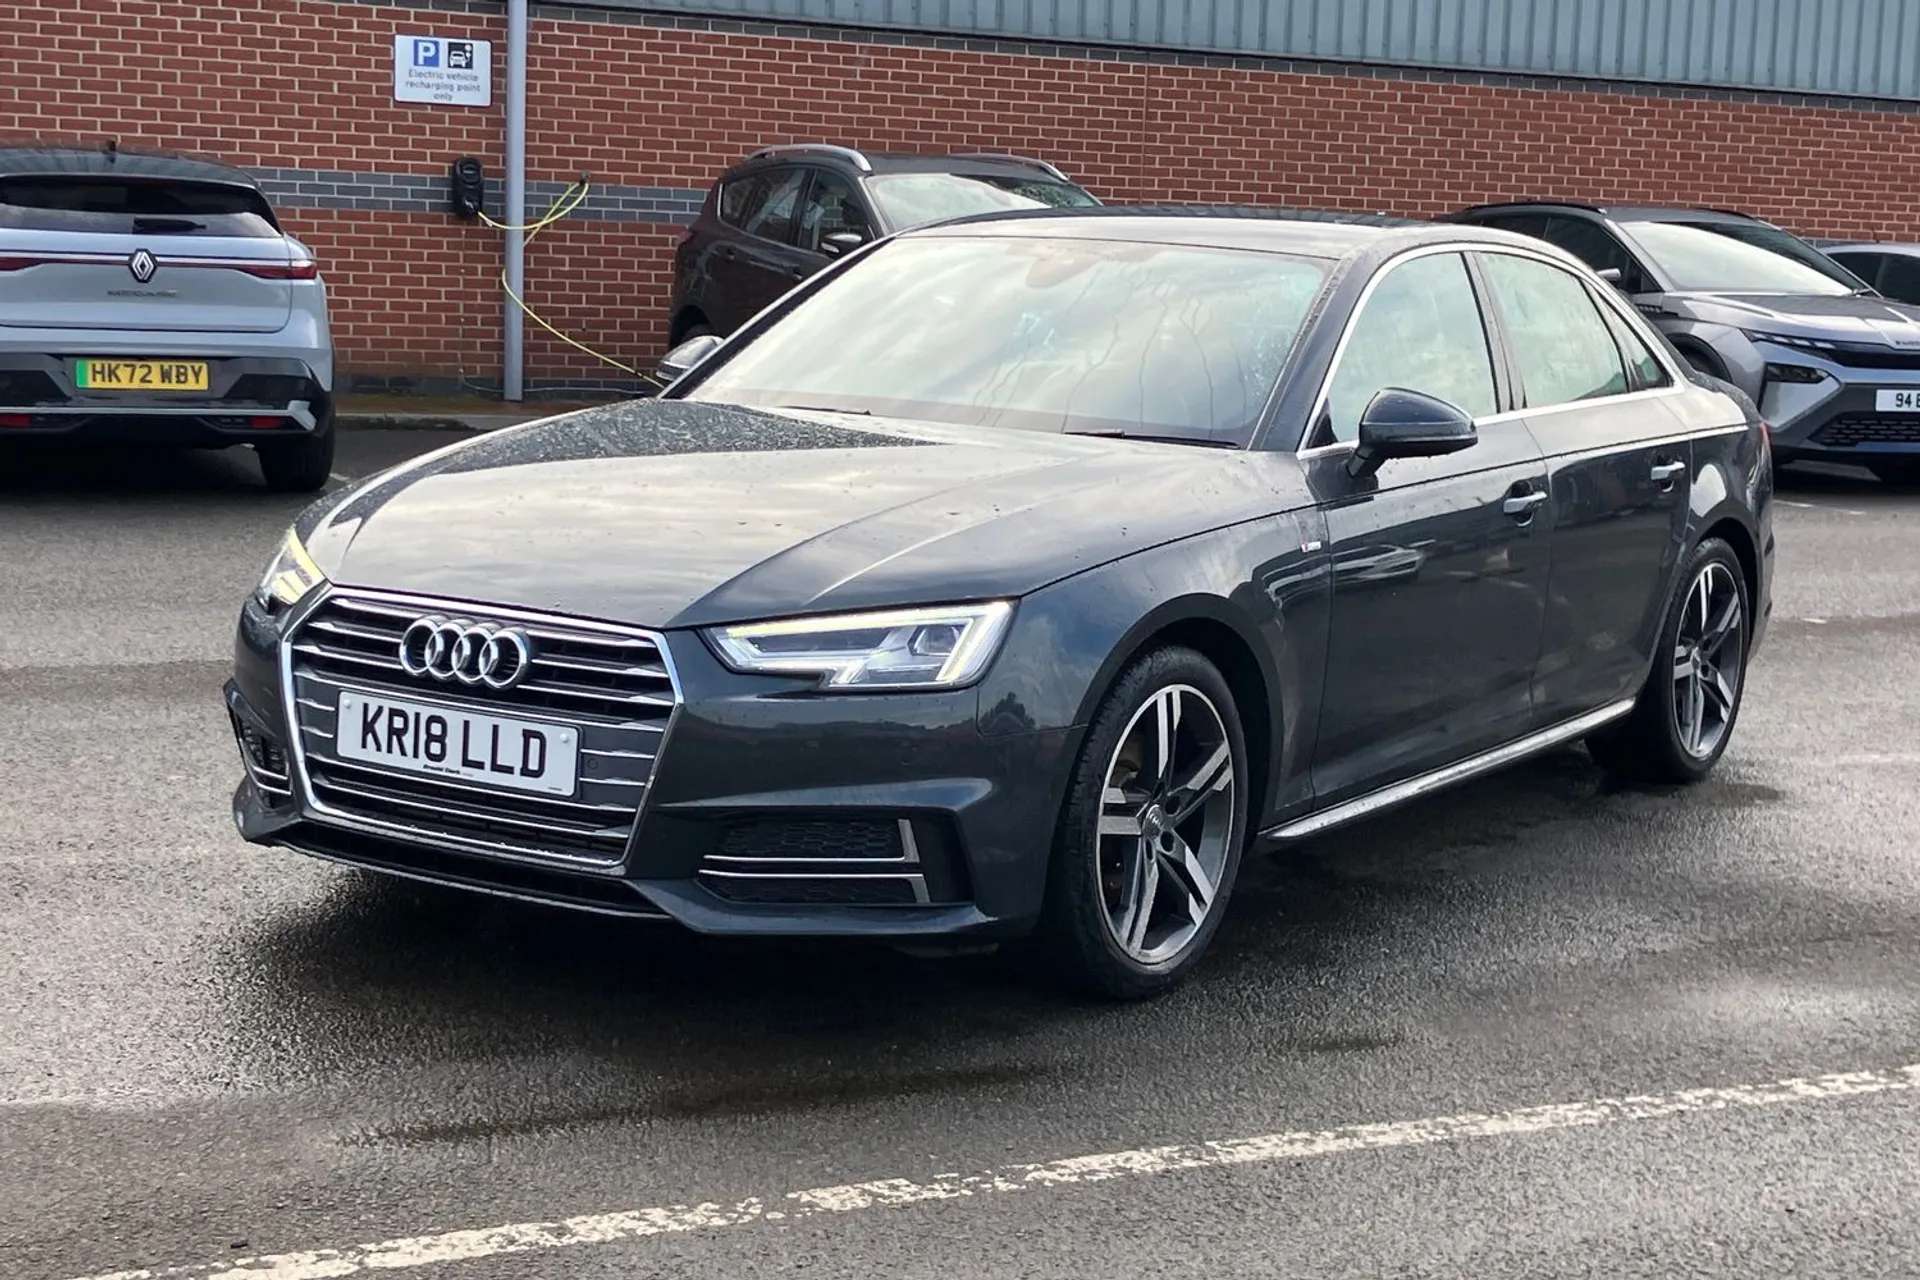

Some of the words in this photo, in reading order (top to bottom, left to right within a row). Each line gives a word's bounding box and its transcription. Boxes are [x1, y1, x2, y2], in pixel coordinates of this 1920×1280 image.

[418, 42, 436, 65] P
[408, 69, 444, 79] Electric
[446, 72, 479, 81] vehicle
[405, 79, 454, 92] recharging
[456, 82, 481, 92] point
[433, 92, 453, 102] only
[91, 363, 153, 383] HK72
[160, 364, 203, 384] WBY
[1895, 393, 1912, 408] 94
[361, 702, 448, 763] KR18
[461, 719, 547, 779] LLD
